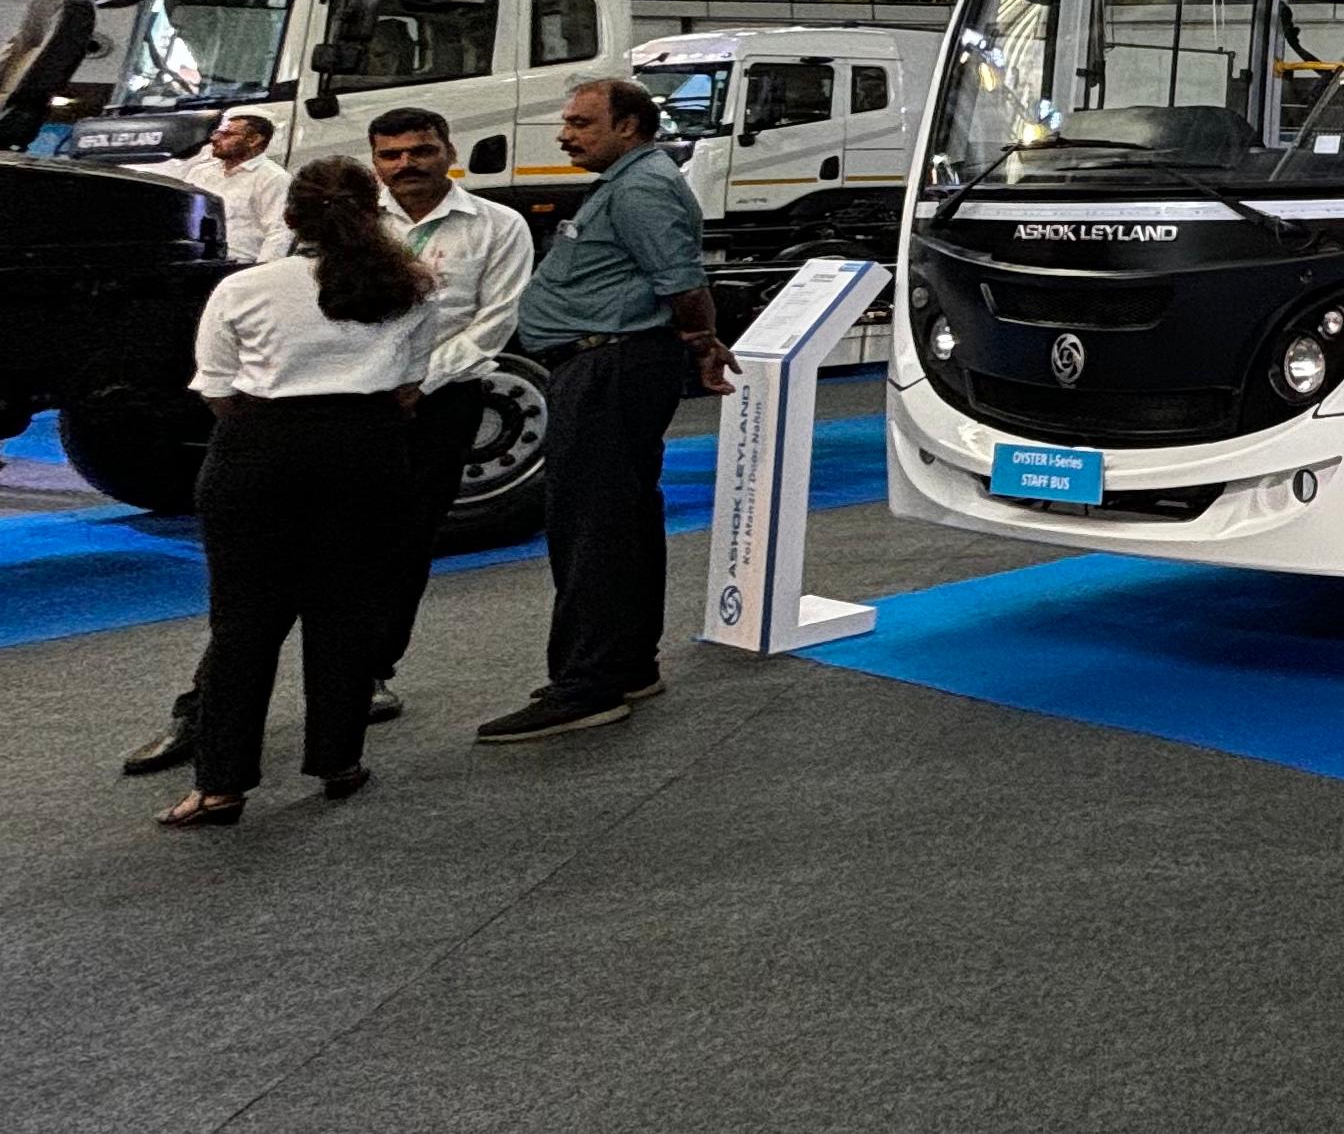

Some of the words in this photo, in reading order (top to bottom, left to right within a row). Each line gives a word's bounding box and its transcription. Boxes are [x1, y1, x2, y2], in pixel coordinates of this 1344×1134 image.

[1013, 223, 1077, 241] ASHOK
[1079, 224, 1179, 242] LEYLAND
[734, 385, 750, 490] LEYLAND
[1012, 450, 1046, 466] OYSTER
[1020, 473, 1048, 488] STAFF
[1050, 475, 1070, 490] BUS
[728, 496, 742, 578] ASHOK
